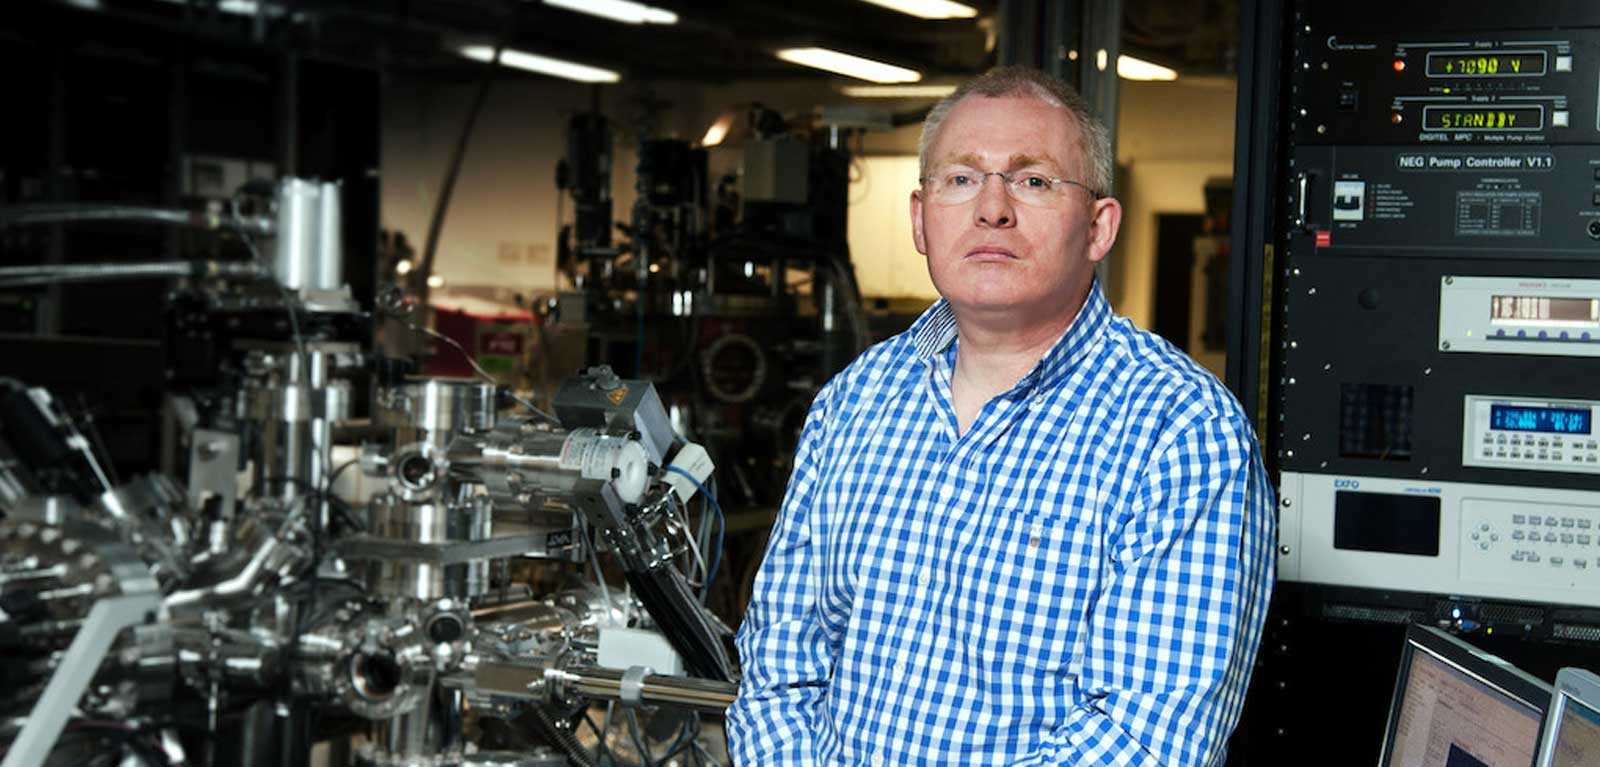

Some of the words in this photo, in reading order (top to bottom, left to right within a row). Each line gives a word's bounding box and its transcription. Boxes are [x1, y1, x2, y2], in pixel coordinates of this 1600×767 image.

[1511, 59, 1521, 73] V
[1441, 111, 1516, 129] STANDBY
[1419, 133, 1448, 141] DIGITEL
[1454, 133, 1472, 141] MPC
[1484, 134, 1504, 142] Multiple
[1507, 134, 1523, 142] Pump
[1400, 156, 1424, 167] NEG
[1429, 157, 1461, 168] Pump
[1466, 156, 1521, 167] Controller
[1527, 157, 1551, 167] V1.1
[1334, 480, 1360, 489] EXFO
